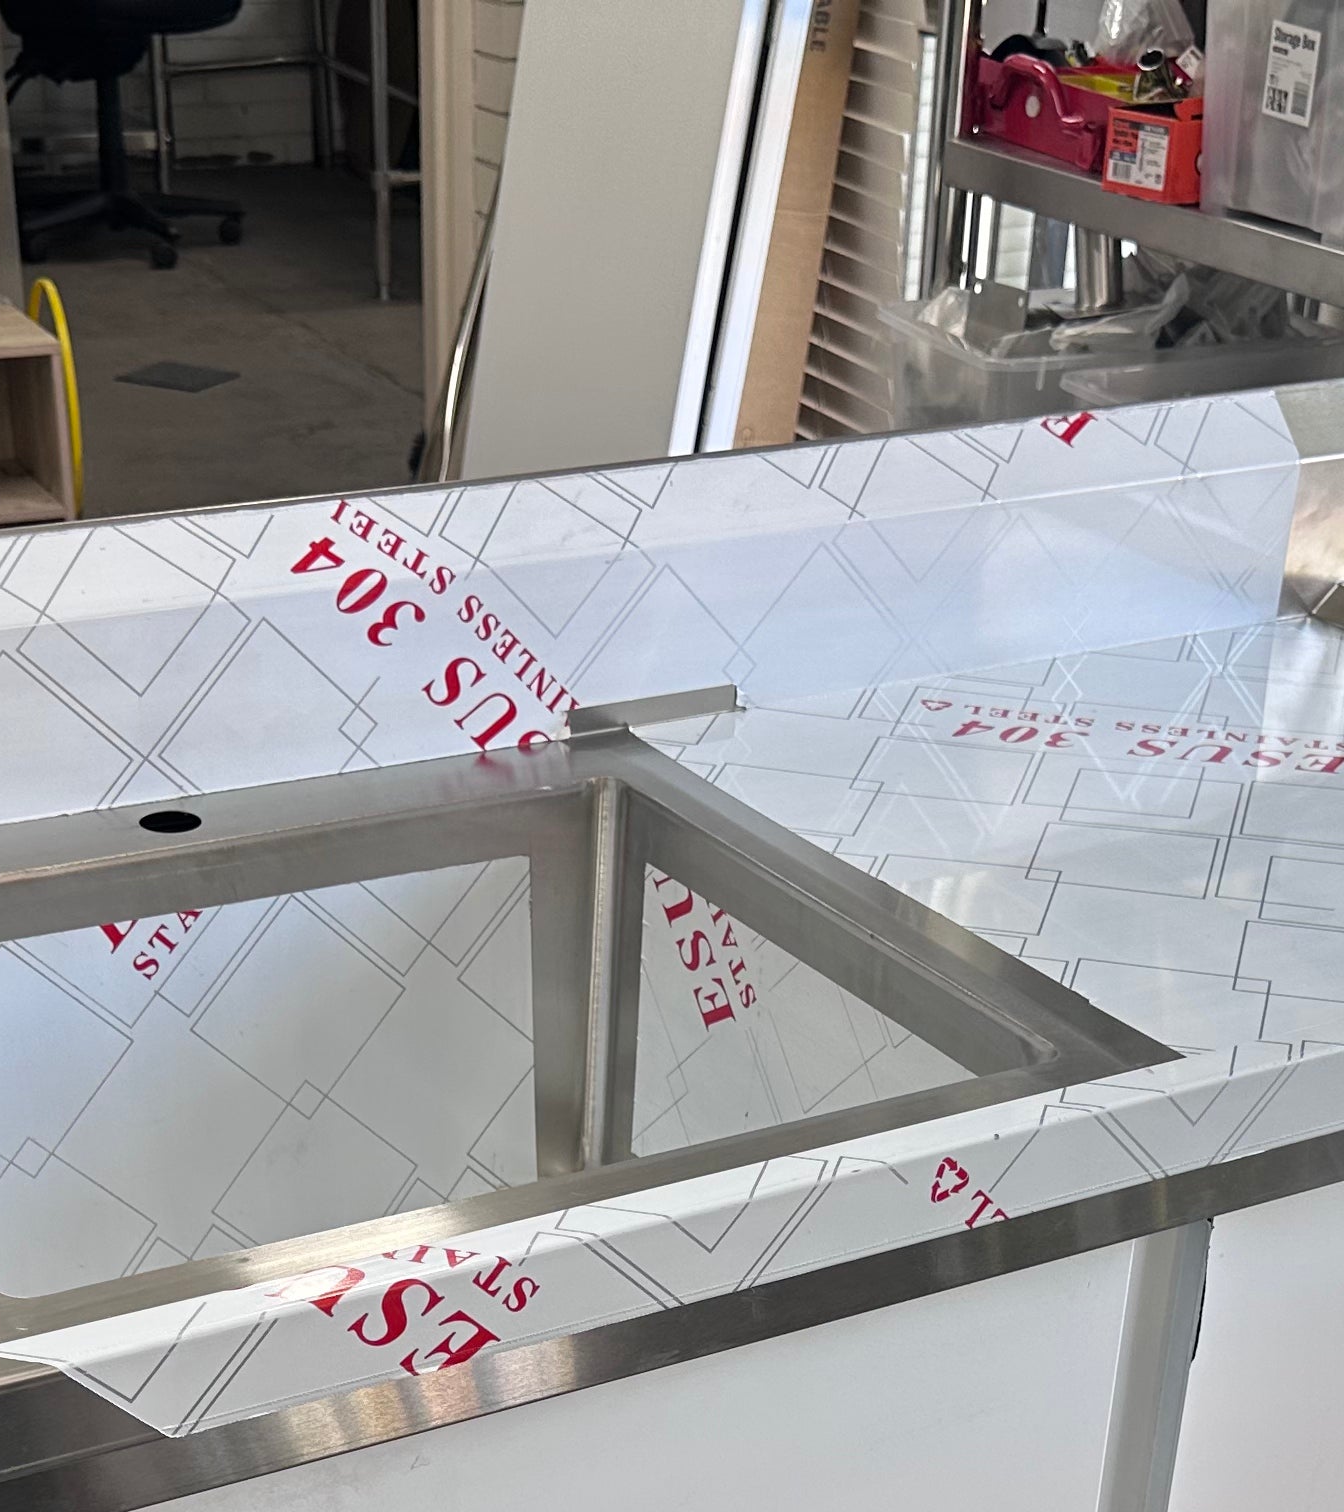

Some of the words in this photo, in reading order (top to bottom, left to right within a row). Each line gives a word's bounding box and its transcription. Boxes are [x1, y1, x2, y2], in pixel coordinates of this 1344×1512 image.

[1274, 26, 1301, 50] Storage
[1301, 33, 1316, 52] Box
[290, 536, 425, 647] 304
[964, 703, 1096, 729] STEEL
[952, 719, 1090, 749] 304
